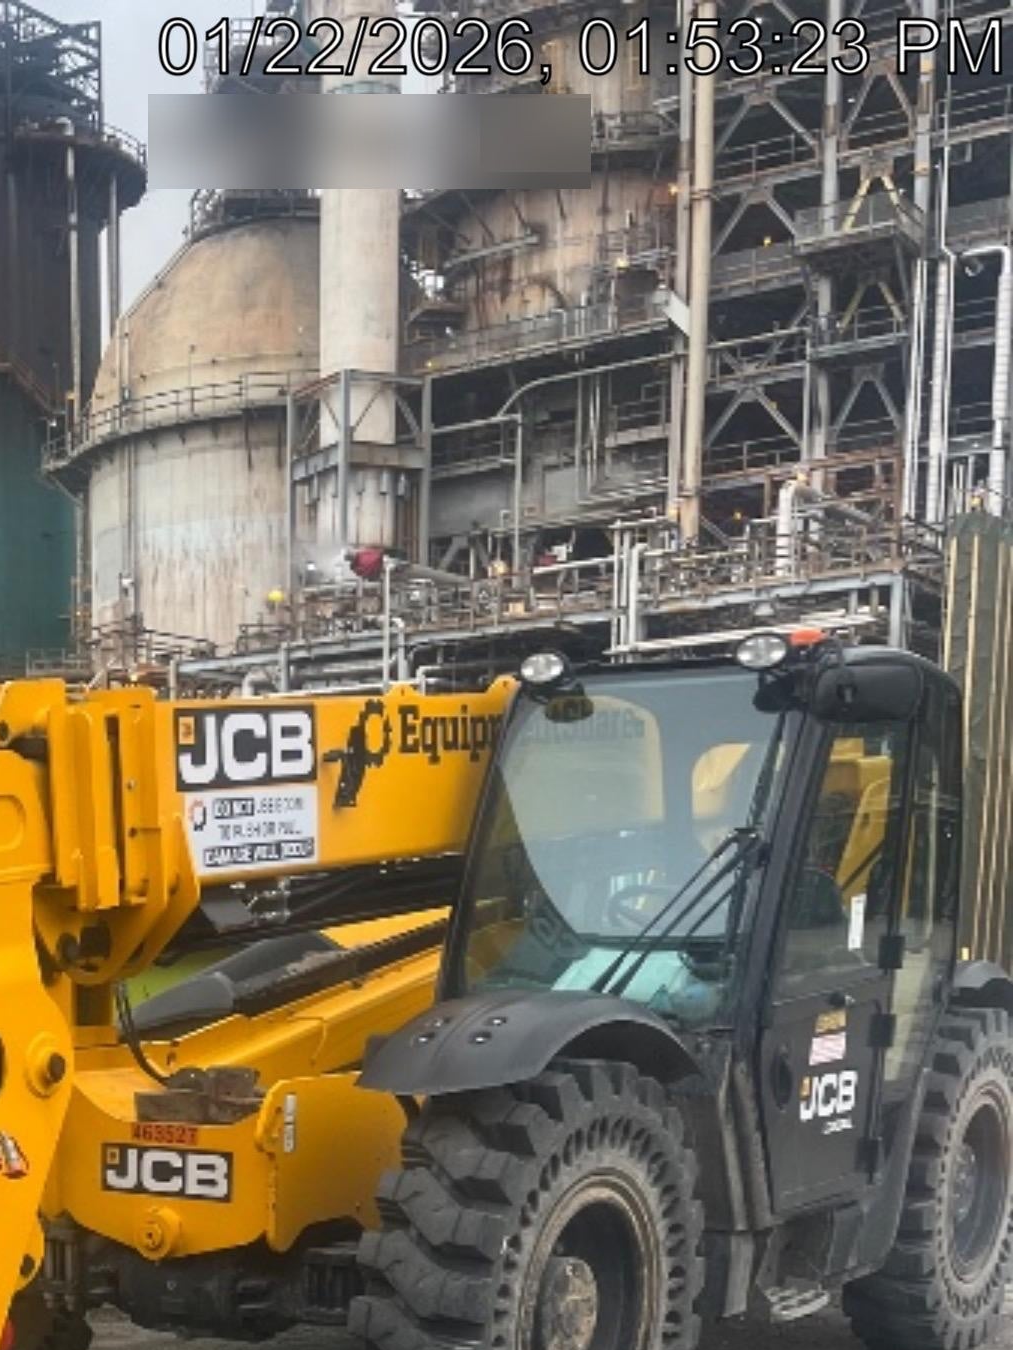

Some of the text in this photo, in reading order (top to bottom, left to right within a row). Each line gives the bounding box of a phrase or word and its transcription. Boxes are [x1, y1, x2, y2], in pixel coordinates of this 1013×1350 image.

[178, 710, 314, 784] JCB
[799, 1070, 858, 1122] JCB
[106, 1147, 229, 1199] JCB
